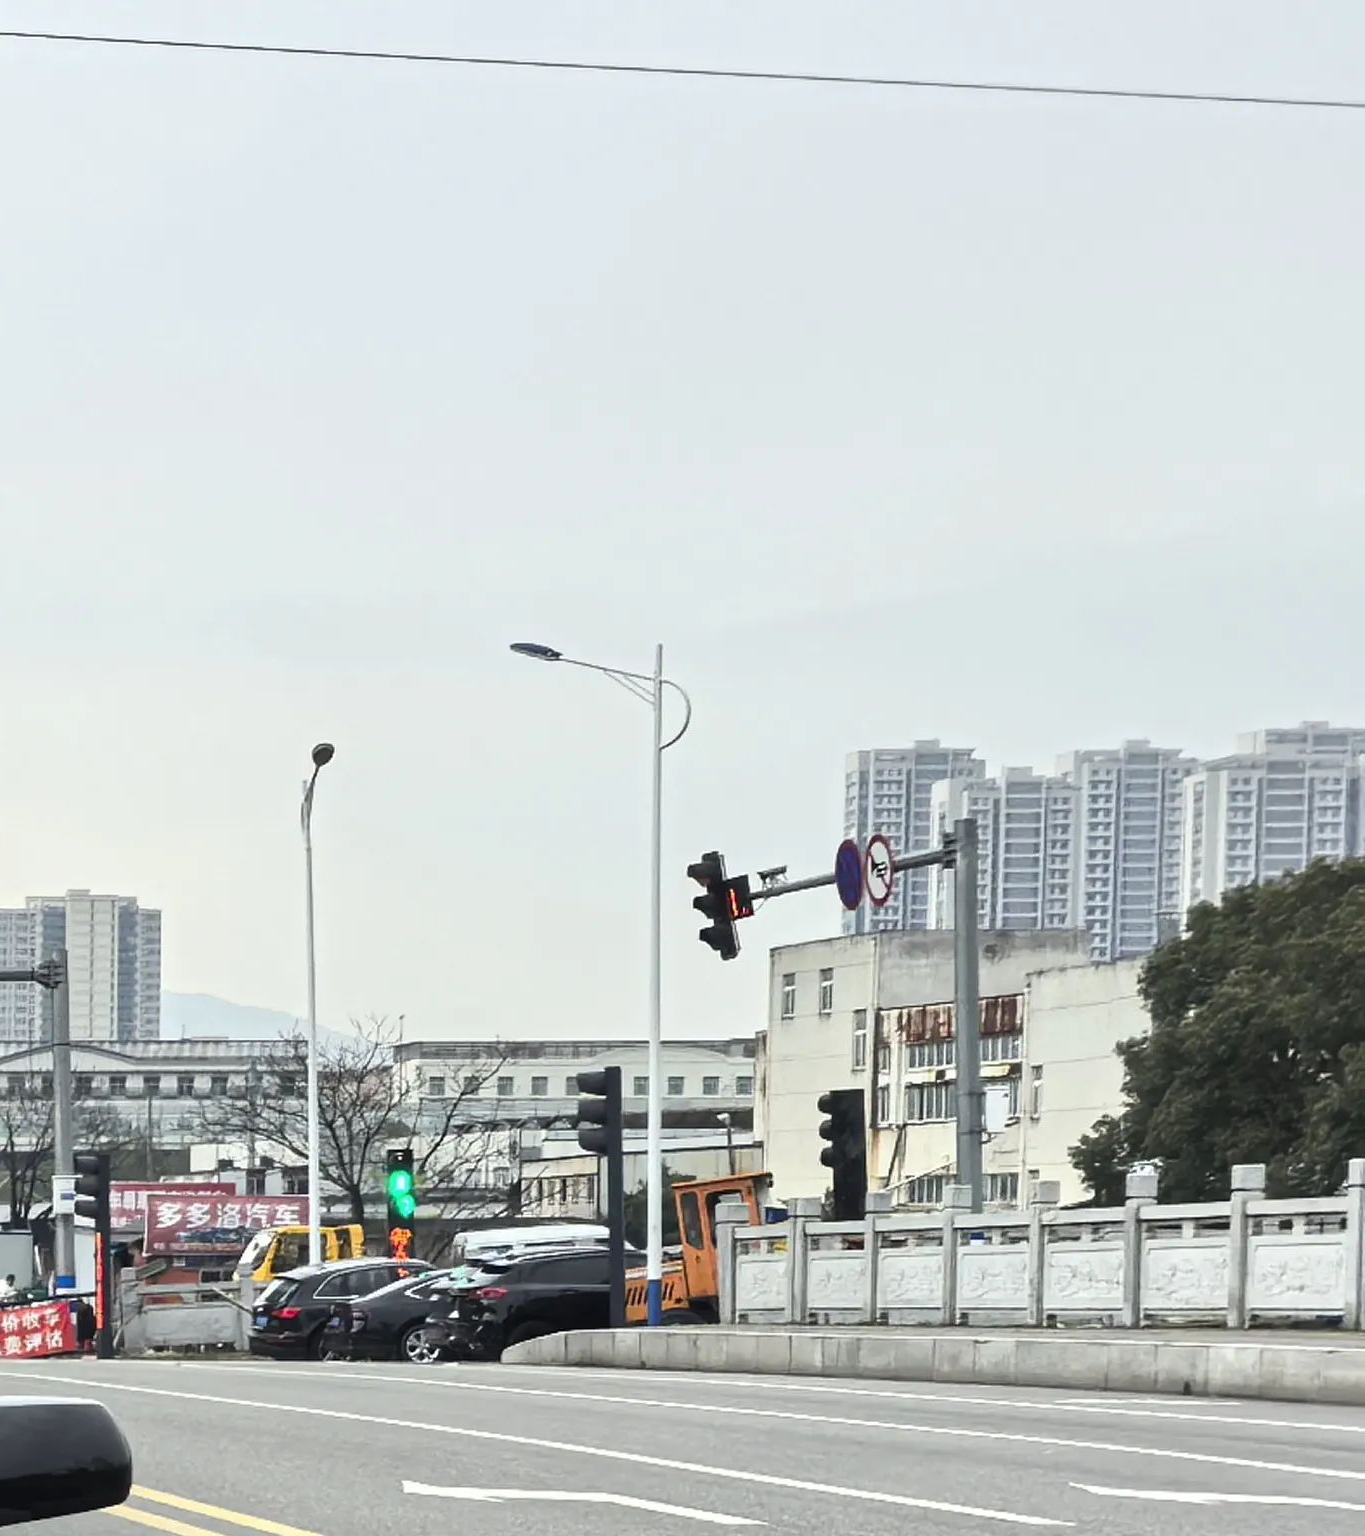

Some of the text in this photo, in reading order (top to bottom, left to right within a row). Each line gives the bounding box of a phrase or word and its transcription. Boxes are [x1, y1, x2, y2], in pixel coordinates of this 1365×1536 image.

[155, 1202, 300, 1229] 多多洛汽车
